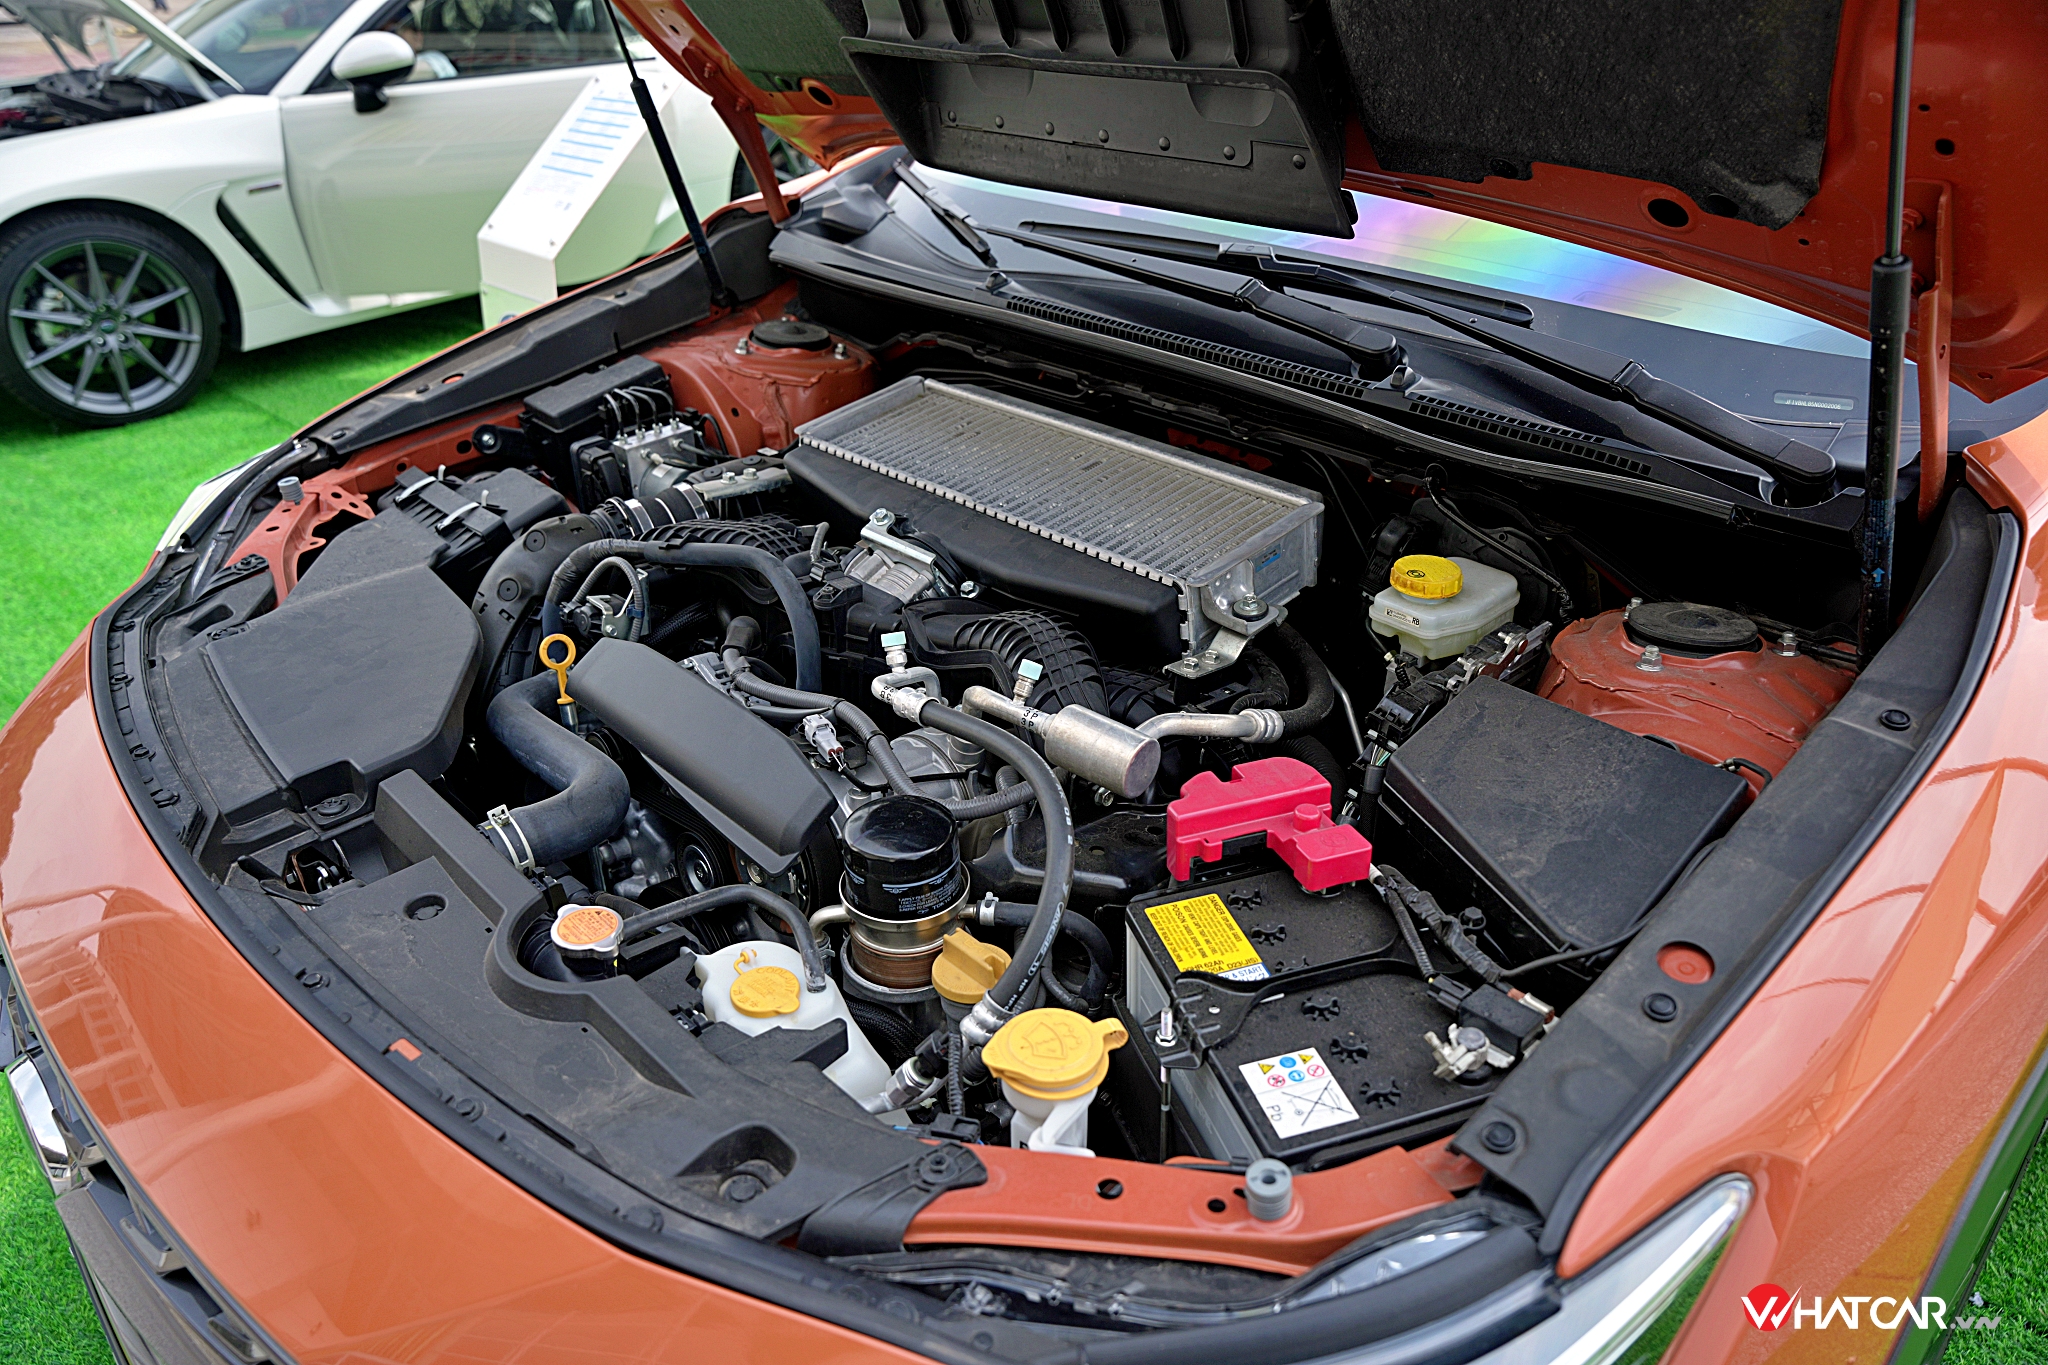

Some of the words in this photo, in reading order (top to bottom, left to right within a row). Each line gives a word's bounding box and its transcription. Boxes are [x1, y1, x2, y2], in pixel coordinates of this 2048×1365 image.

[1411, 617, 1420, 626] RB
[1207, 896, 1225, 915] DANGER
[1170, 904, 1187, 923] POISON
[1204, 960, 1225, 968] 62Ah
[1239, 966, 1263, 977] START
[1266, 1104, 1284, 1121] Pb
